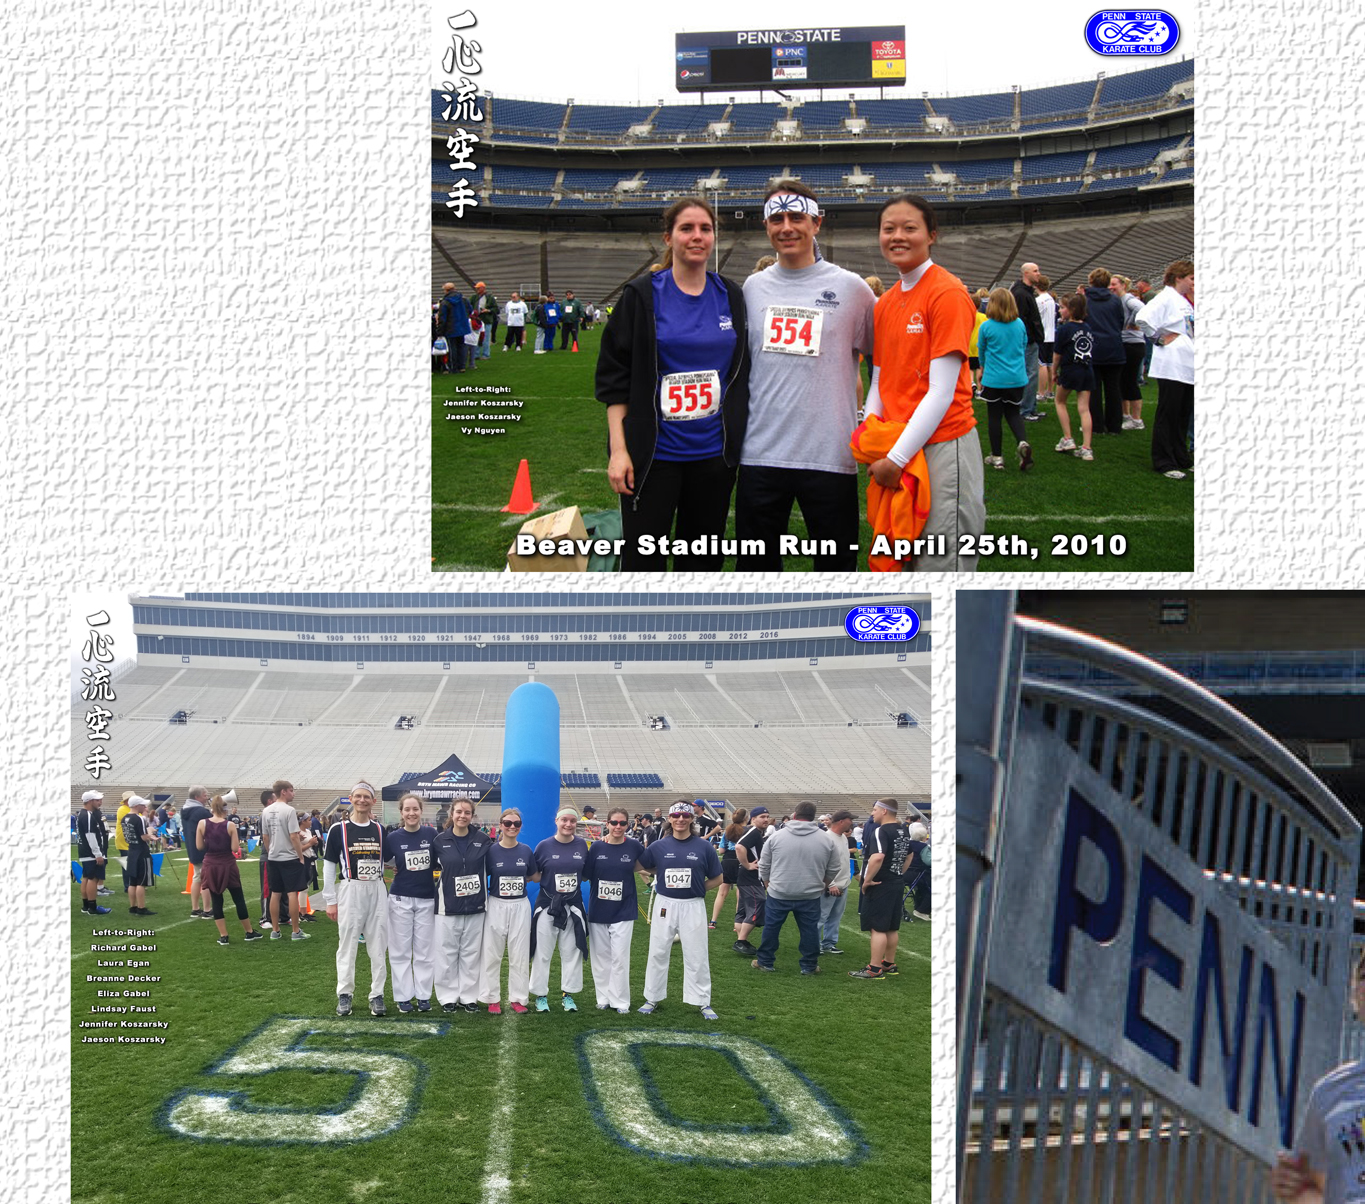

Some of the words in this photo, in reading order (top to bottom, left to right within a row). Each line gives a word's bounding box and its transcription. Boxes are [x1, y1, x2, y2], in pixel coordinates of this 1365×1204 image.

[737, 31, 781, 44] PENN
[795, 29, 841, 42] STATE
[769, 316, 813, 348] 554
[668, 382, 713, 414] 555
[666, 874, 691, 885] 1047
[1047, 787, 1306, 1151] PENN
